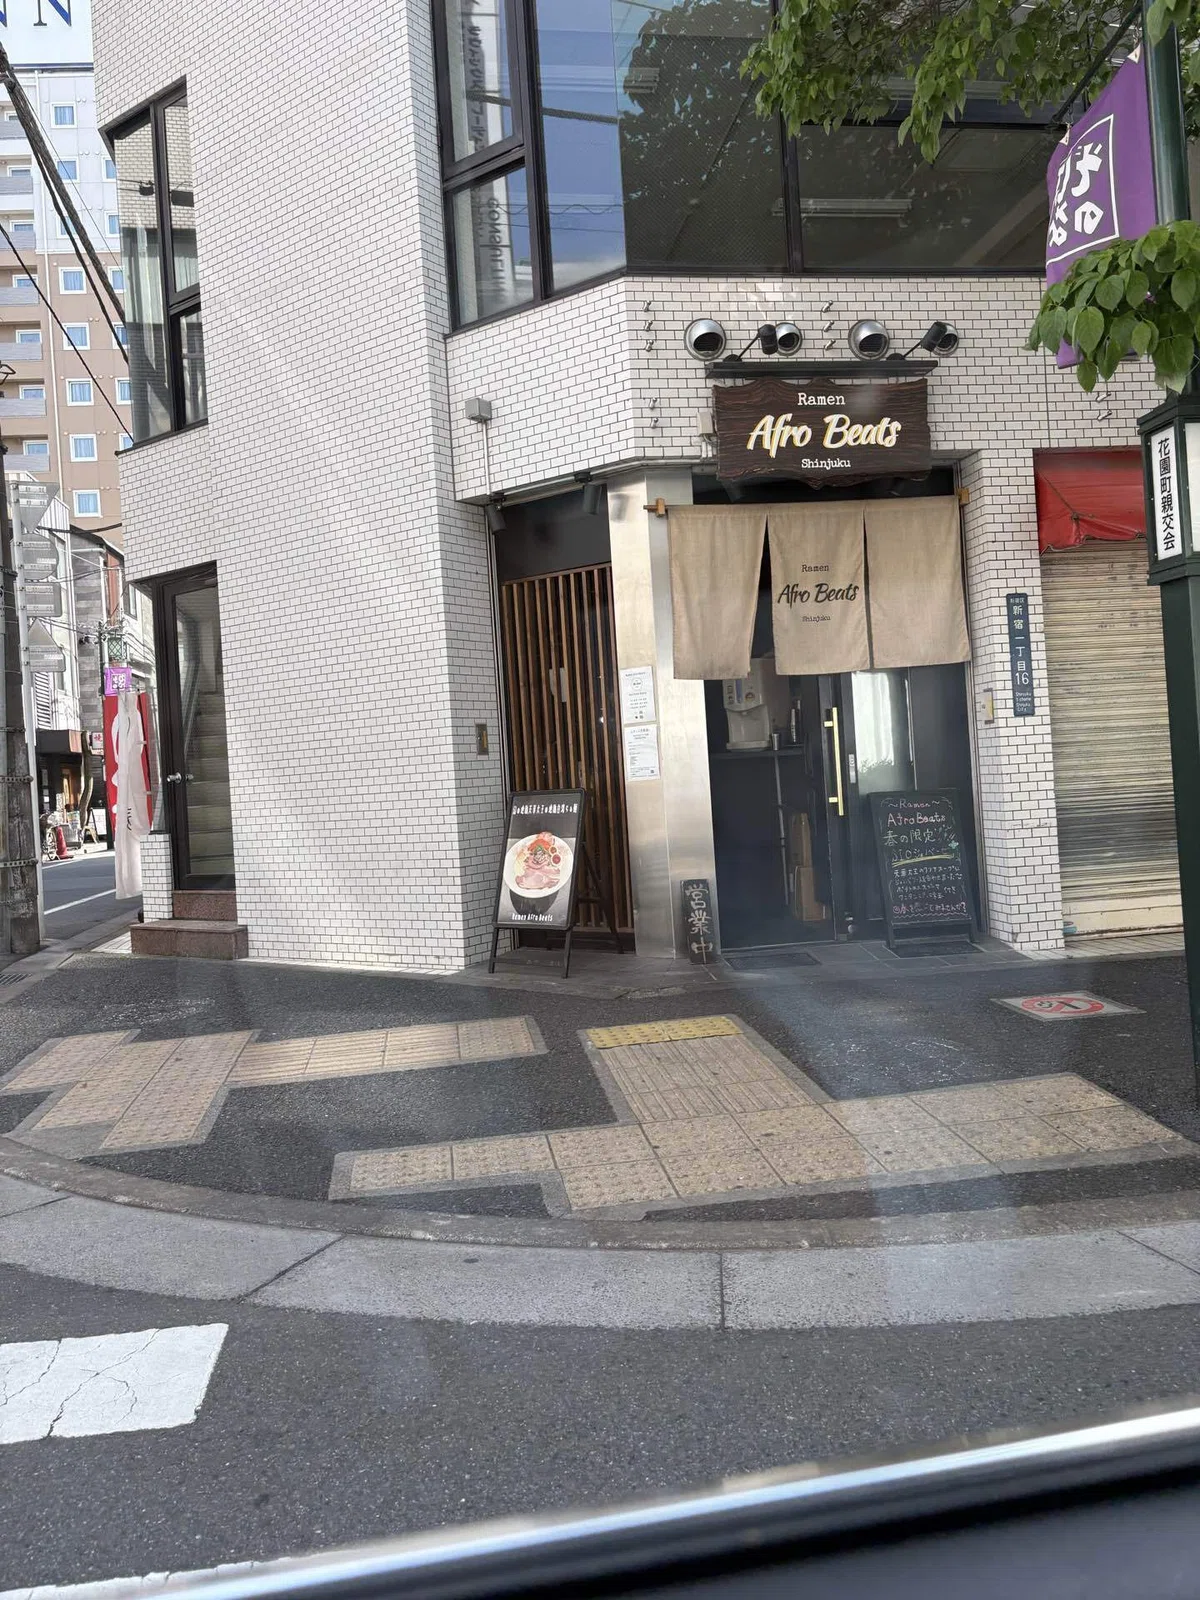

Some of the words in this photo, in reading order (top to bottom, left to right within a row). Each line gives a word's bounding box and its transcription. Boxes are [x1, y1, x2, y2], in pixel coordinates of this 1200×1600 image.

[797, 392, 846, 406] Ramen
[747, 413, 813, 458] Afro
[823, 413, 902, 449] Beats
[801, 458, 851, 470] Shinjuku
[1158, 437, 1176, 551] 花園町親交会
[801, 563, 830, 573] Ramen
[777, 582, 810, 608] Afro
[814, 583, 859, 604] Beats
[684, 883, 714, 964] 営業中
